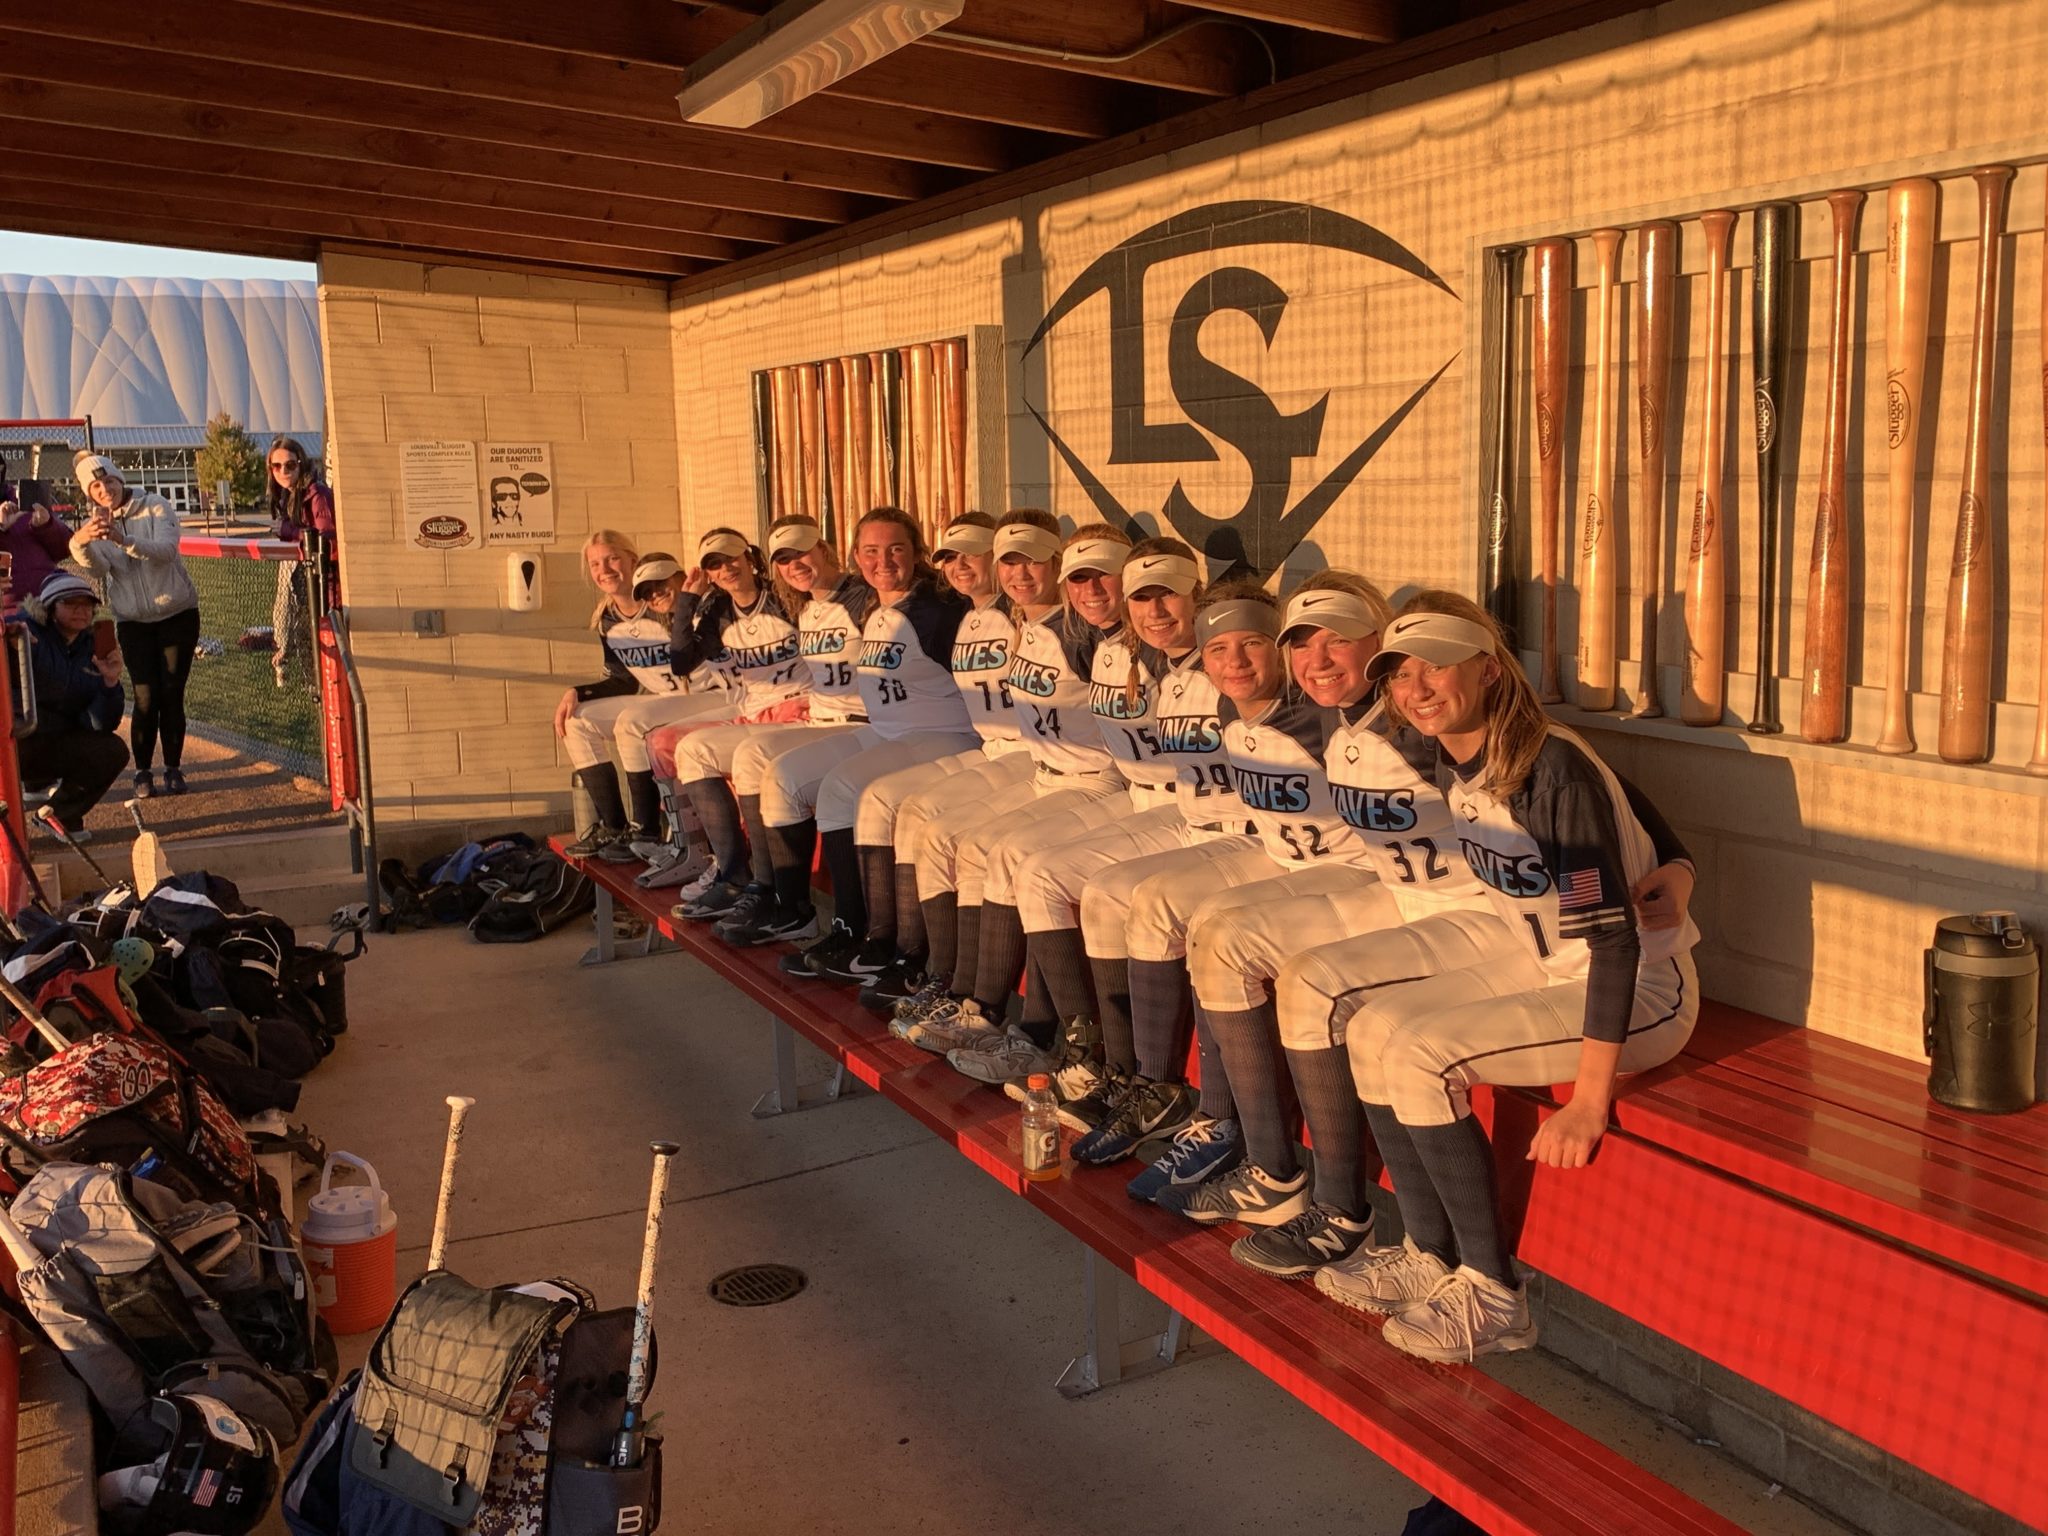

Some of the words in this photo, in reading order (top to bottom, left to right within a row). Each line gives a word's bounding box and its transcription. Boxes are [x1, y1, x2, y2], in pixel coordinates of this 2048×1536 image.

[1757, 394, 1770, 447] Slugger
[1889, 386, 1904, 443] Slugger
[426, 522, 463, 535] Slugger
[1122, 727, 1162, 761] 15
[1280, 824, 1330, 860] 52
[1383, 836, 1450, 883] 32
[1459, 838, 1553, 898] AVES
[1521, 911, 1554, 959] 1
[1229, 1184, 1268, 1210] N
[1307, 1227, 1346, 1260] N
[226, 1485, 244, 1505] 15
